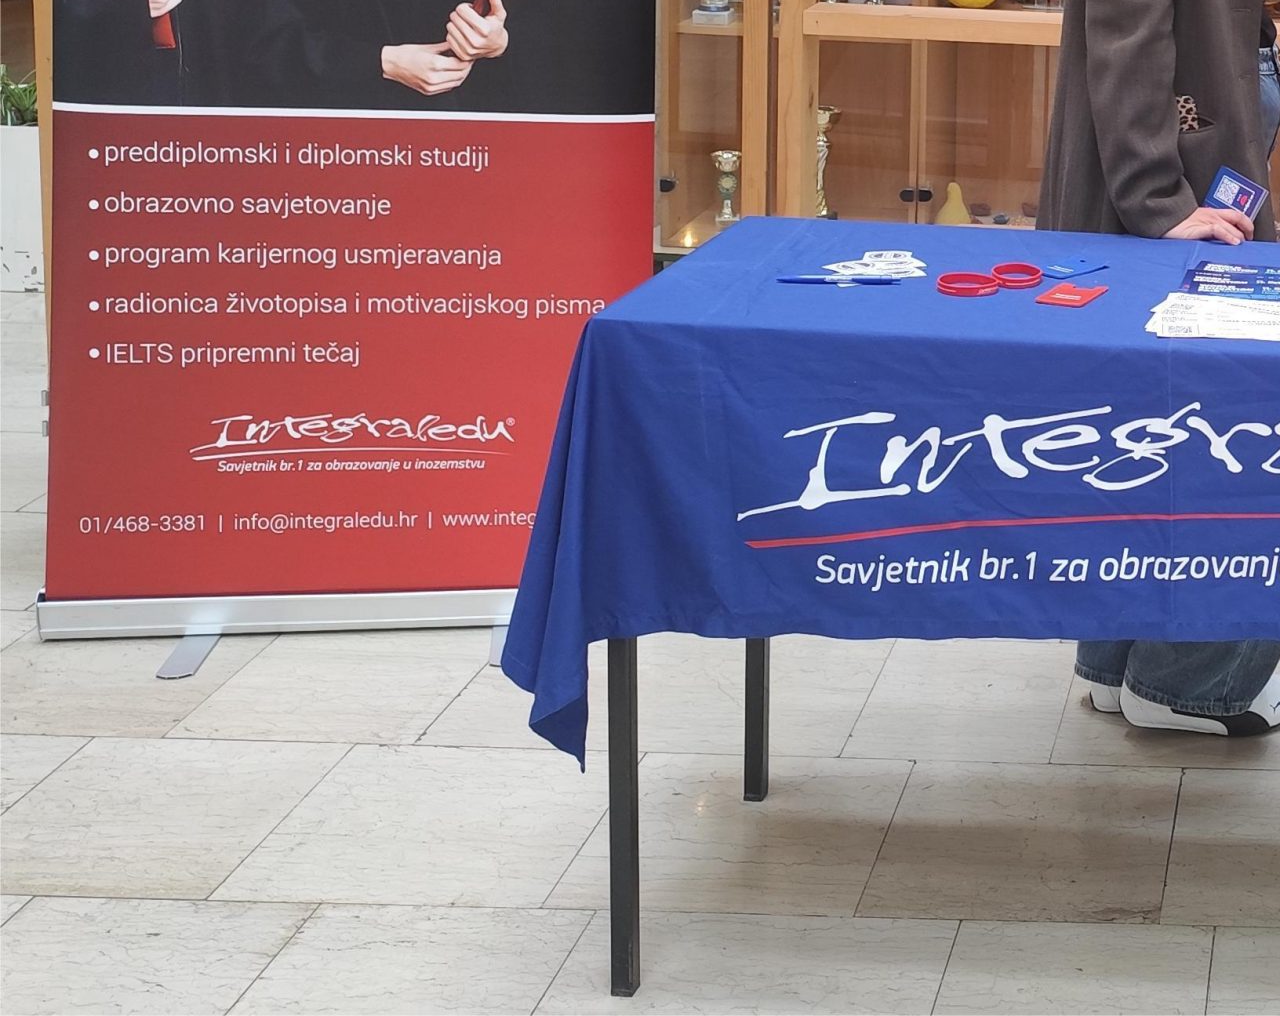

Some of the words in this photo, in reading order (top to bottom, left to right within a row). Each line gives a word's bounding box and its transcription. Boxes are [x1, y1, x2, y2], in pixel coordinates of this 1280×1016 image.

[105, 141, 277, 168] preddiplomski
[284, 141, 291, 165] i
[298, 142, 412, 170] diplomski
[419, 145, 489, 172] studiji
[104, 191, 234, 214] obrazovno
[242, 192, 391, 220] savjetovanje
[105, 246, 210, 269] program
[218, 242, 337, 269] karijernog
[344, 243, 501, 270] usmjeravanja
[105, 292, 218, 314] radionica
[226, 292, 347, 318] životopisa
[354, 291, 361, 314] i
[367, 292, 528, 319] motivacijskog
[535, 294, 605, 319] pisma
[106, 343, 173, 364] IELTS
[181, 341, 296, 368] pripremni
[302, 341, 360, 368] tečaj
[217, 459, 277, 475] Savjetnik
[306, 461, 323, 471] za
[325, 458, 401, 473] obrazovanje
[402, 461, 412, 470] u
[414, 458, 486, 470] inozemstvu
[79, 514, 204, 534] 01/468-3381
[234, 510, 418, 534] info@integraledu.hr
[442, 509, 535, 529] www.integ
[815, 549, 971, 592] Savjetnik
[1049, 558, 1089, 582] za
